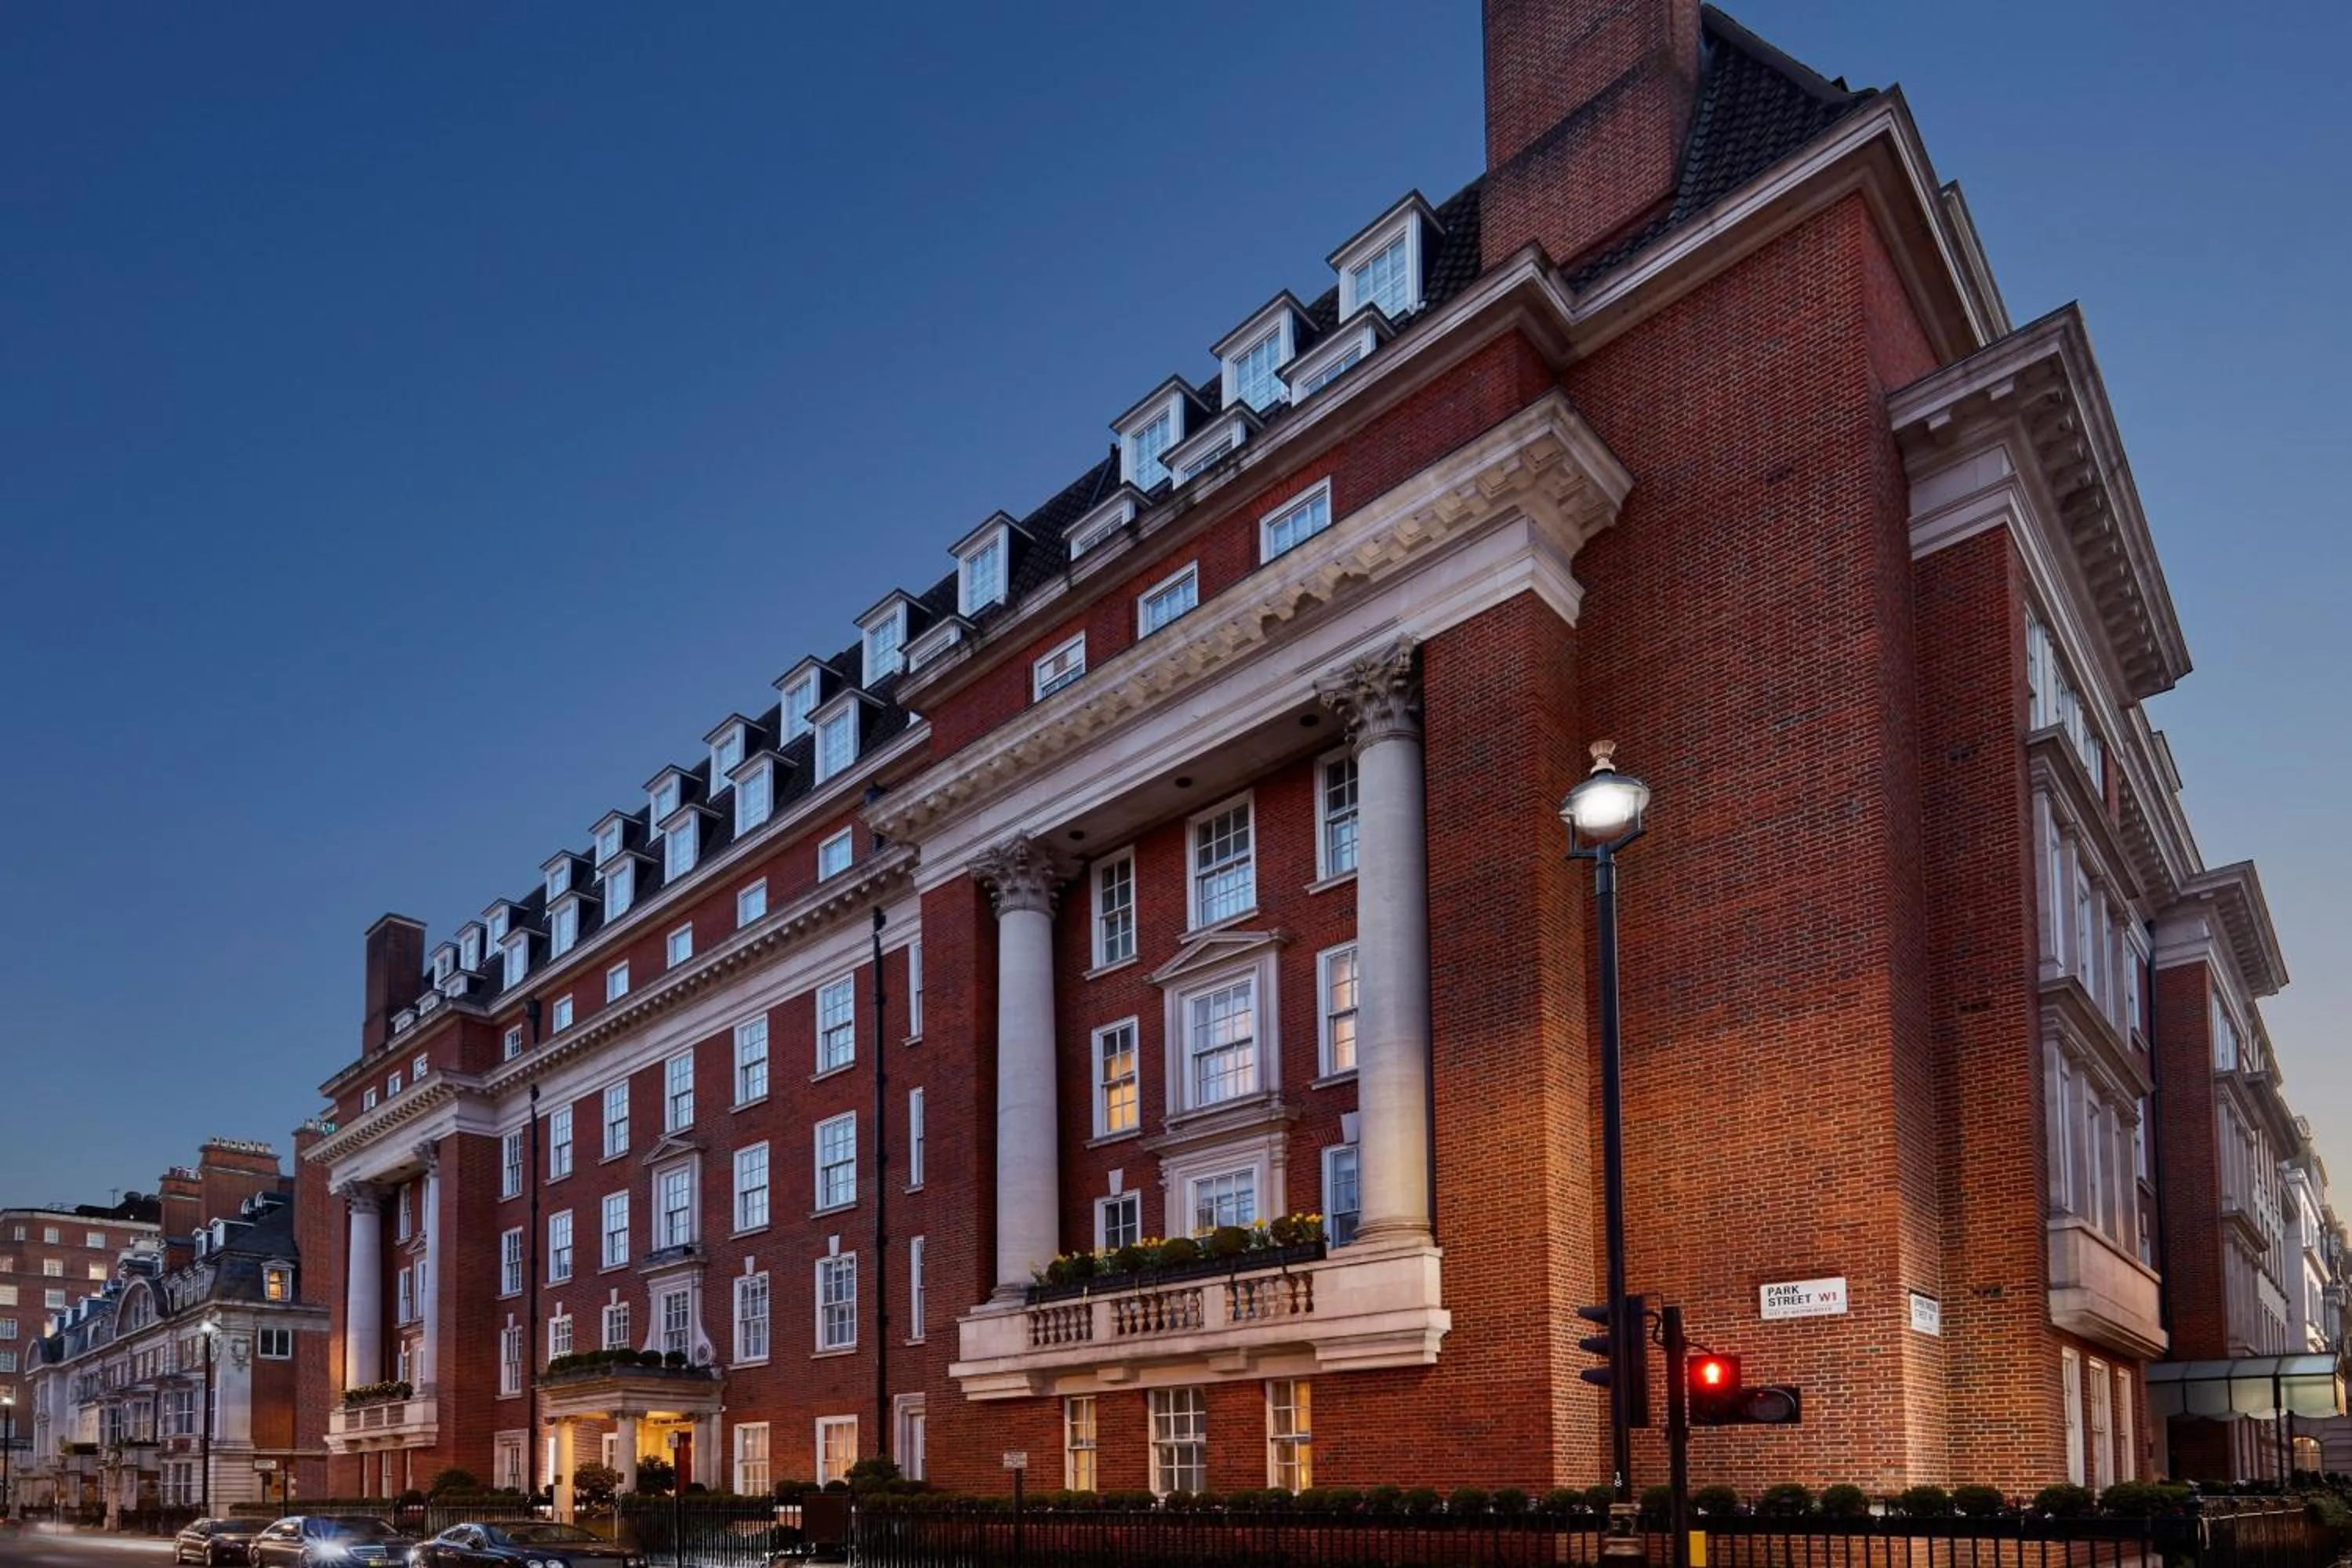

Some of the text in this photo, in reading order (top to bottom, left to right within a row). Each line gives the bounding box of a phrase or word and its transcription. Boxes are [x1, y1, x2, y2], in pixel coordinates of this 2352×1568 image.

[1768, 1285, 1799, 1297] PARK
[1768, 1291, 1837, 1307] STREET W1
